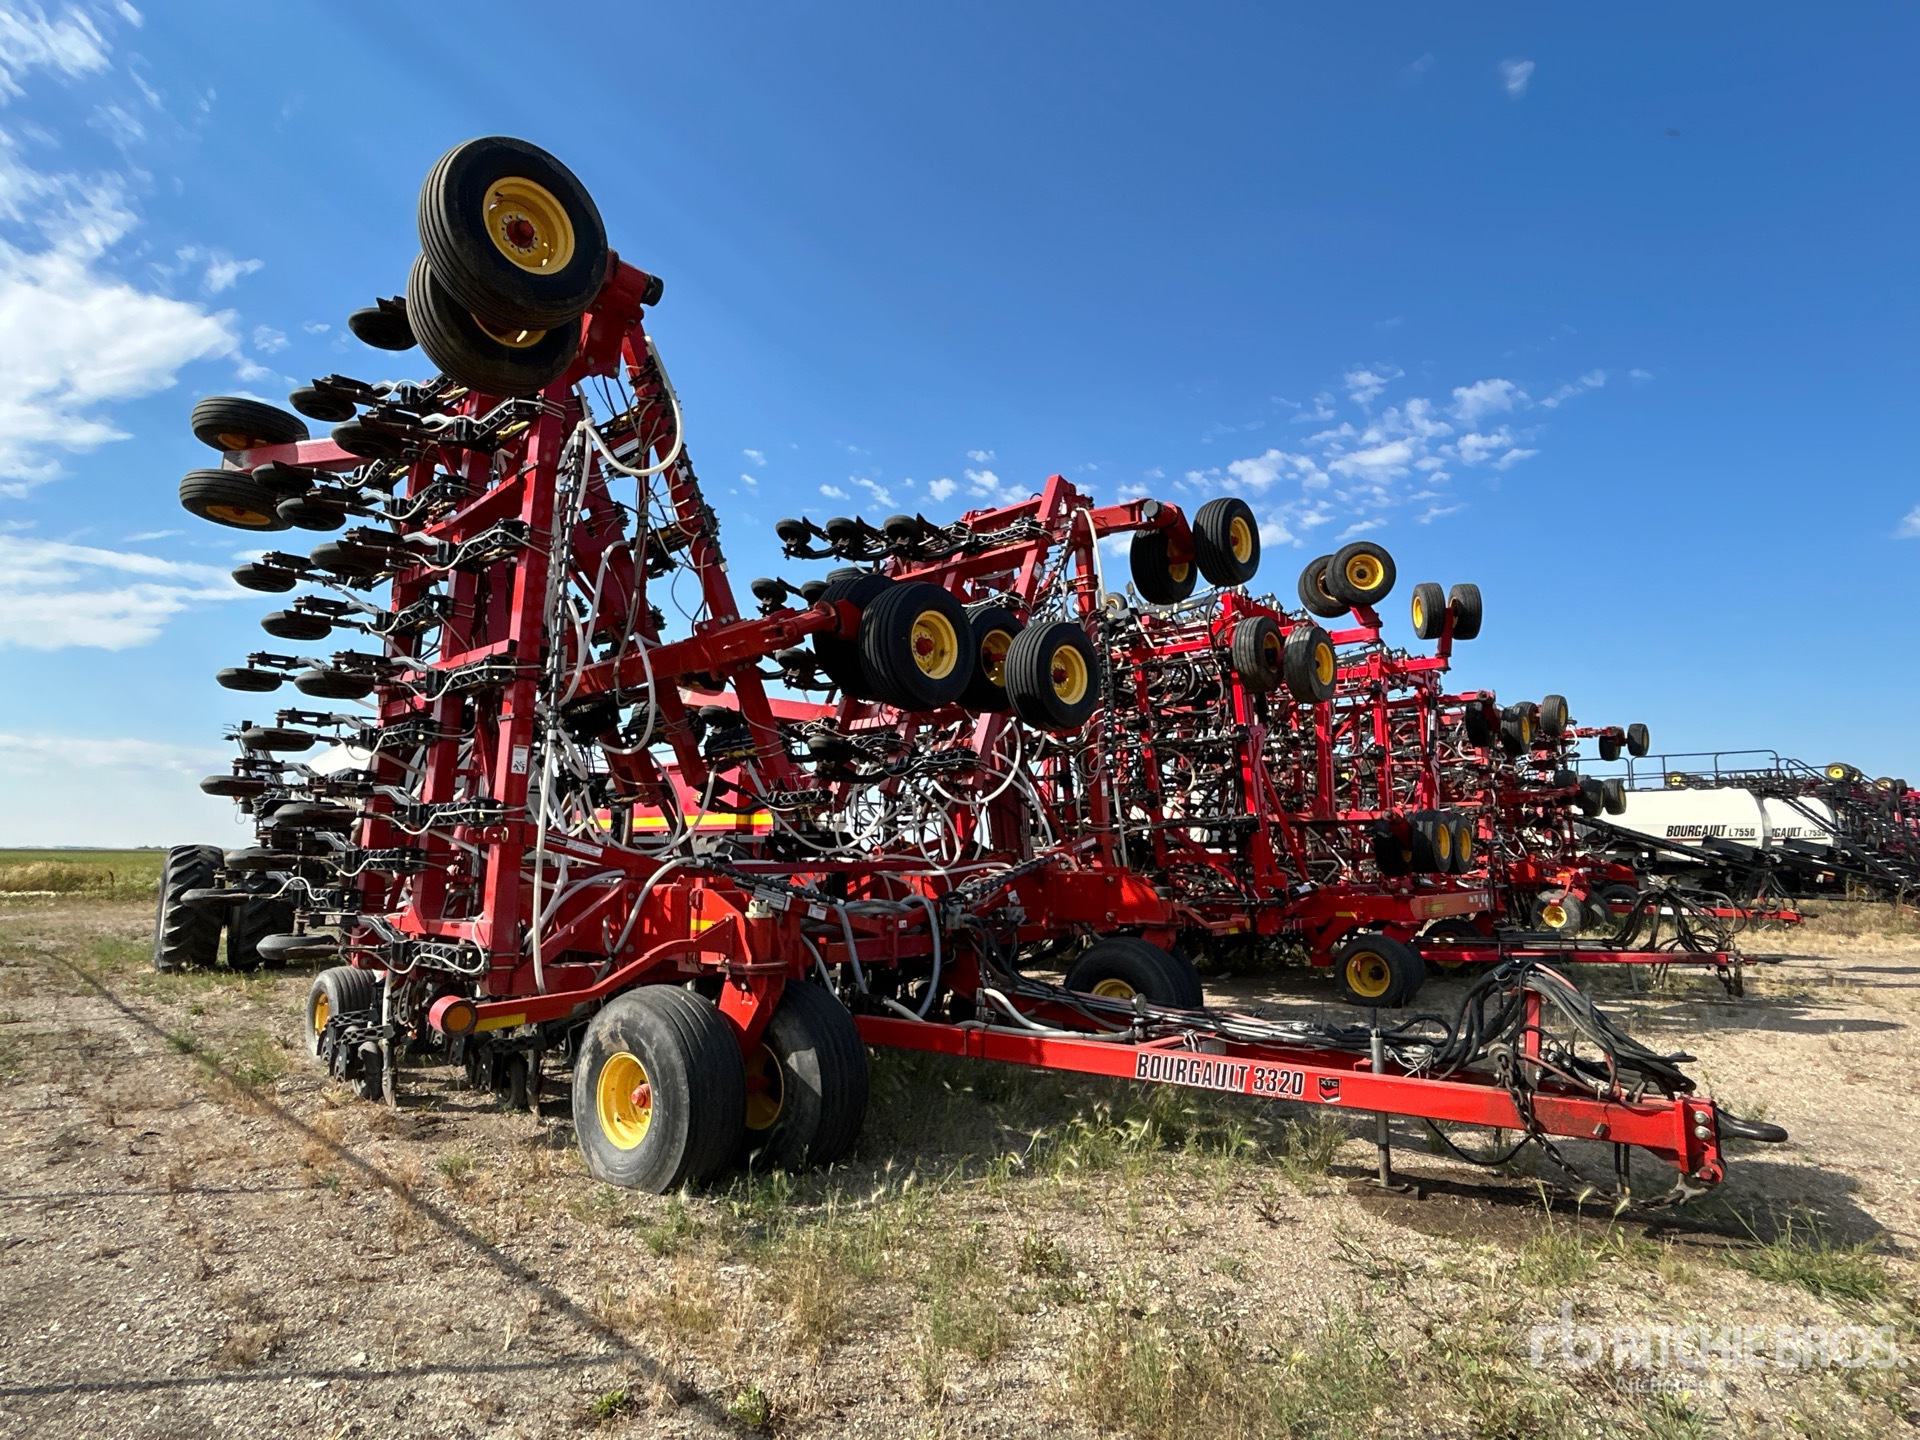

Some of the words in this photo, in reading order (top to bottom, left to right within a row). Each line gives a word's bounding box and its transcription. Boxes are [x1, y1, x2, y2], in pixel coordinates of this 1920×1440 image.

[1666, 824, 1727, 837] BOURGAULT
[1136, 1053, 1249, 1092] BOURGAULT
[1253, 1067, 1304, 1095] 3320
[1320, 1079, 1338, 1087] XTC
